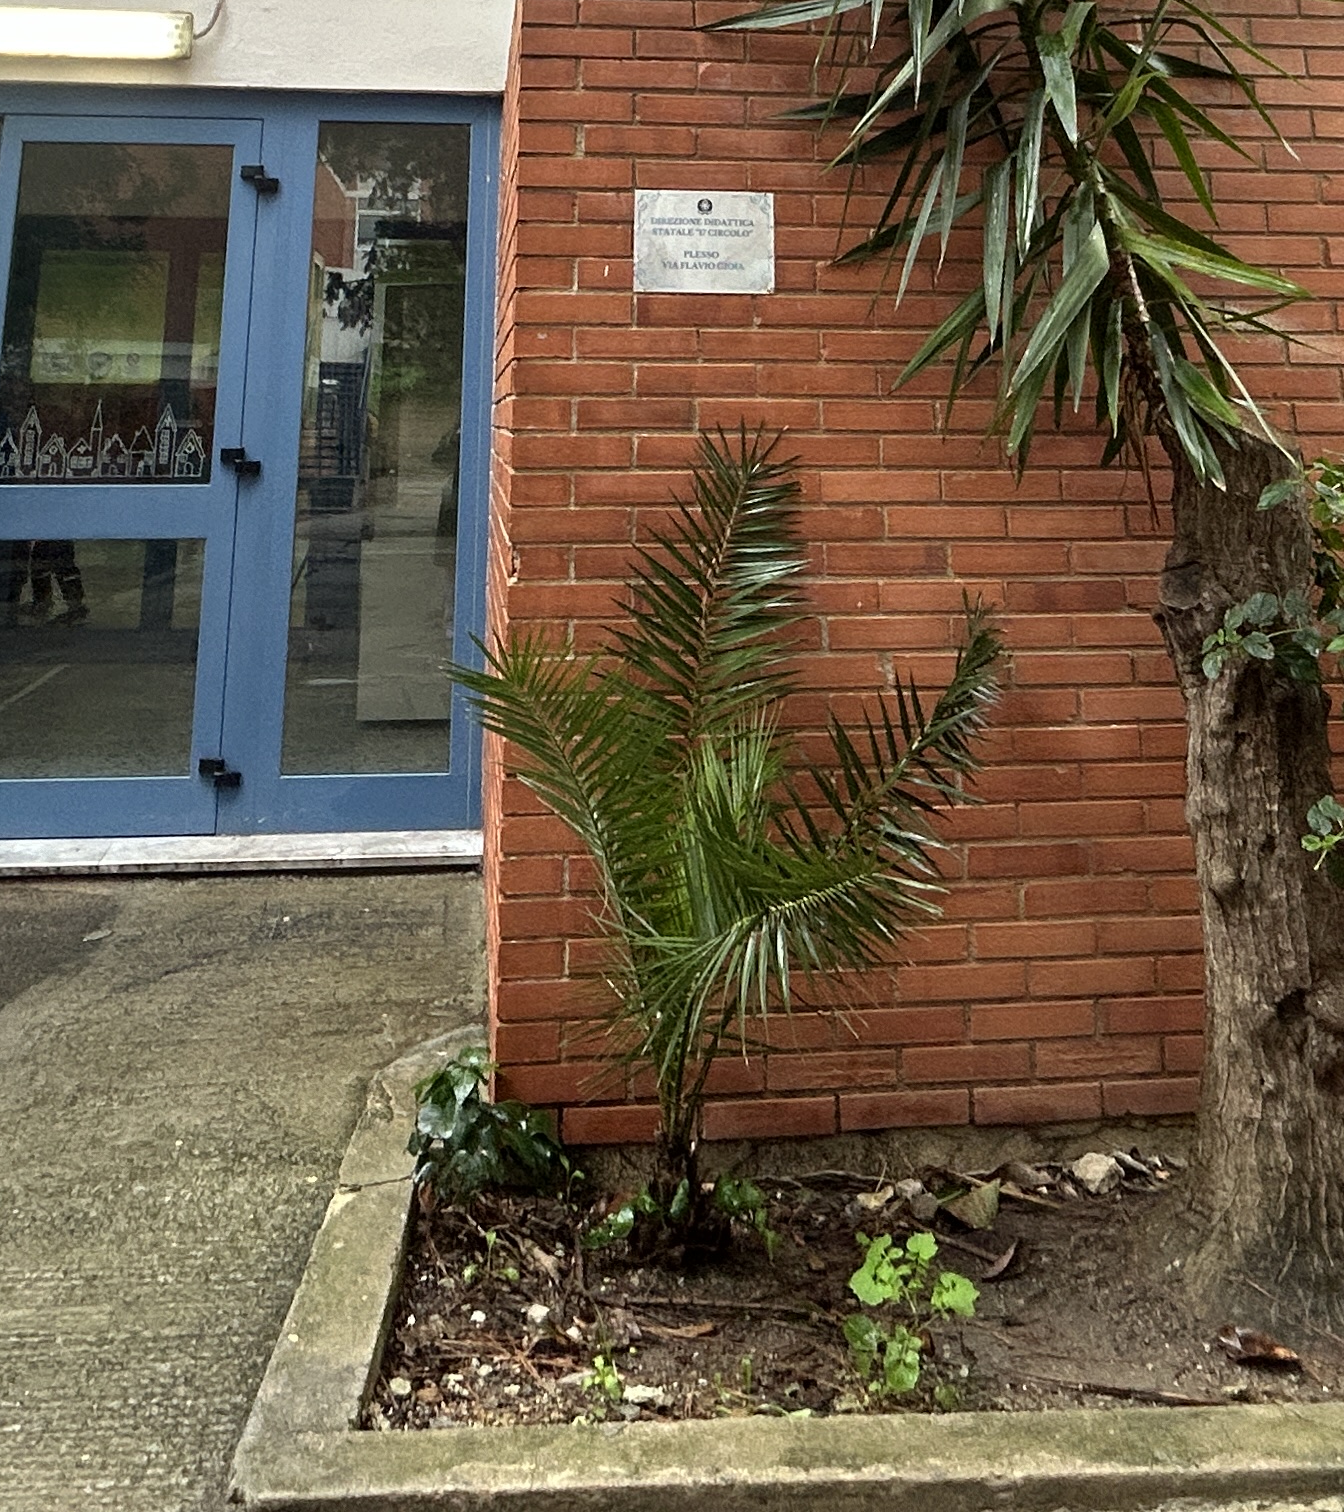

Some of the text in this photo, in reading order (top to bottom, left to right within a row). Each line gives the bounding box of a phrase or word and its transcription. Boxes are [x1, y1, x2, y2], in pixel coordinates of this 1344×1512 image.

[650, 217, 755, 227] DIREZIONE DIDATTICA
[652, 228, 695, 236] STATALE
[683, 250, 720, 259] PLESSO
[662, 260, 745, 270] VIA FLAVIO GIOIA
